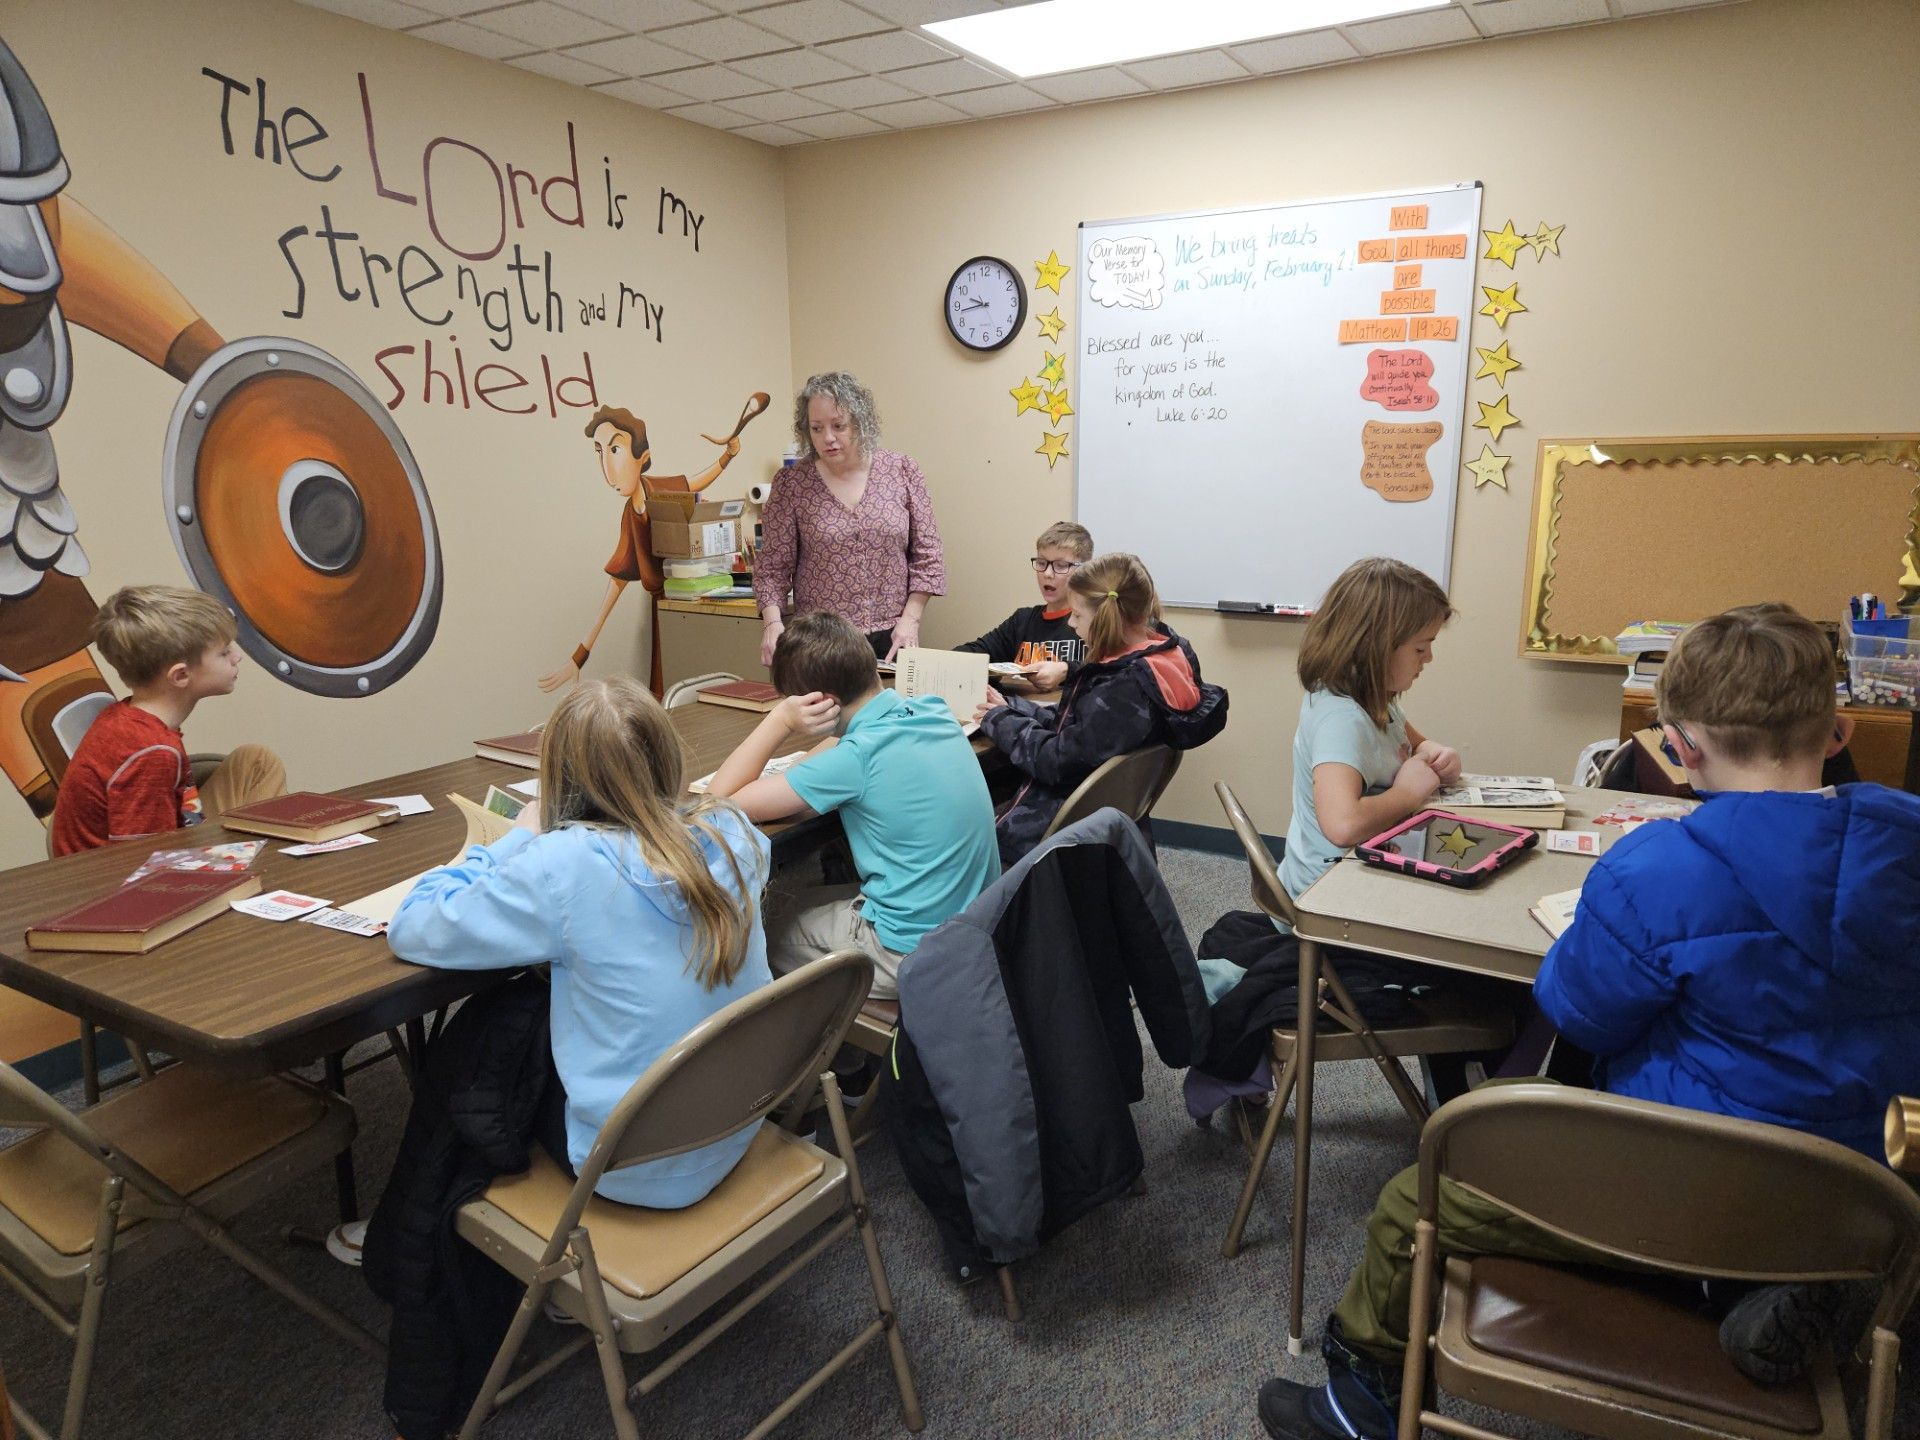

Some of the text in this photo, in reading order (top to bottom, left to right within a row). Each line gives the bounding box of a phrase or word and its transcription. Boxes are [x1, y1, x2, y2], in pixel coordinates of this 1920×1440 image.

[202, 67, 342, 182] The
[603, 156, 628, 230] is
[658, 187, 705, 252] my
[1393, 209, 1424, 228] With
[1175, 222, 1317, 267] We bring treats
[1400, 240, 1418, 258] all
[1093, 244, 1147, 261] Our Memory
[980, 266, 991, 277] 12
[1104, 259, 1127, 271] Verse
[967, 272, 976, 282] 11
[1174, 278, 1190, 293] on
[1264, 256, 1334, 287] February
[1397, 271, 1418, 287] are
[959, 285, 968, 296] 10
[1006, 280, 1013, 292] 2
[954, 301, 961, 312] 9
[1011, 297, 1018, 308] 3
[578, 293, 606, 326] and
[617, 282, 664, 343] my
[1007, 314, 1013, 324] 4
[959, 317, 965, 328] 8
[969, 328, 975, 339] 7
[983, 332, 989, 342] 6
[996, 327, 1003, 338] 5
[1342, 320, 1451, 340] Matthew 19:26
[1087, 331, 1141, 355] Blessed
[1150, 333, 1173, 347] are
[1114, 350, 1226, 385] for yours is the
[1378, 354, 1423, 368] The Lord
[1172, 383, 1185, 398] of
[1156, 406, 1228, 422] Luke 6:20
